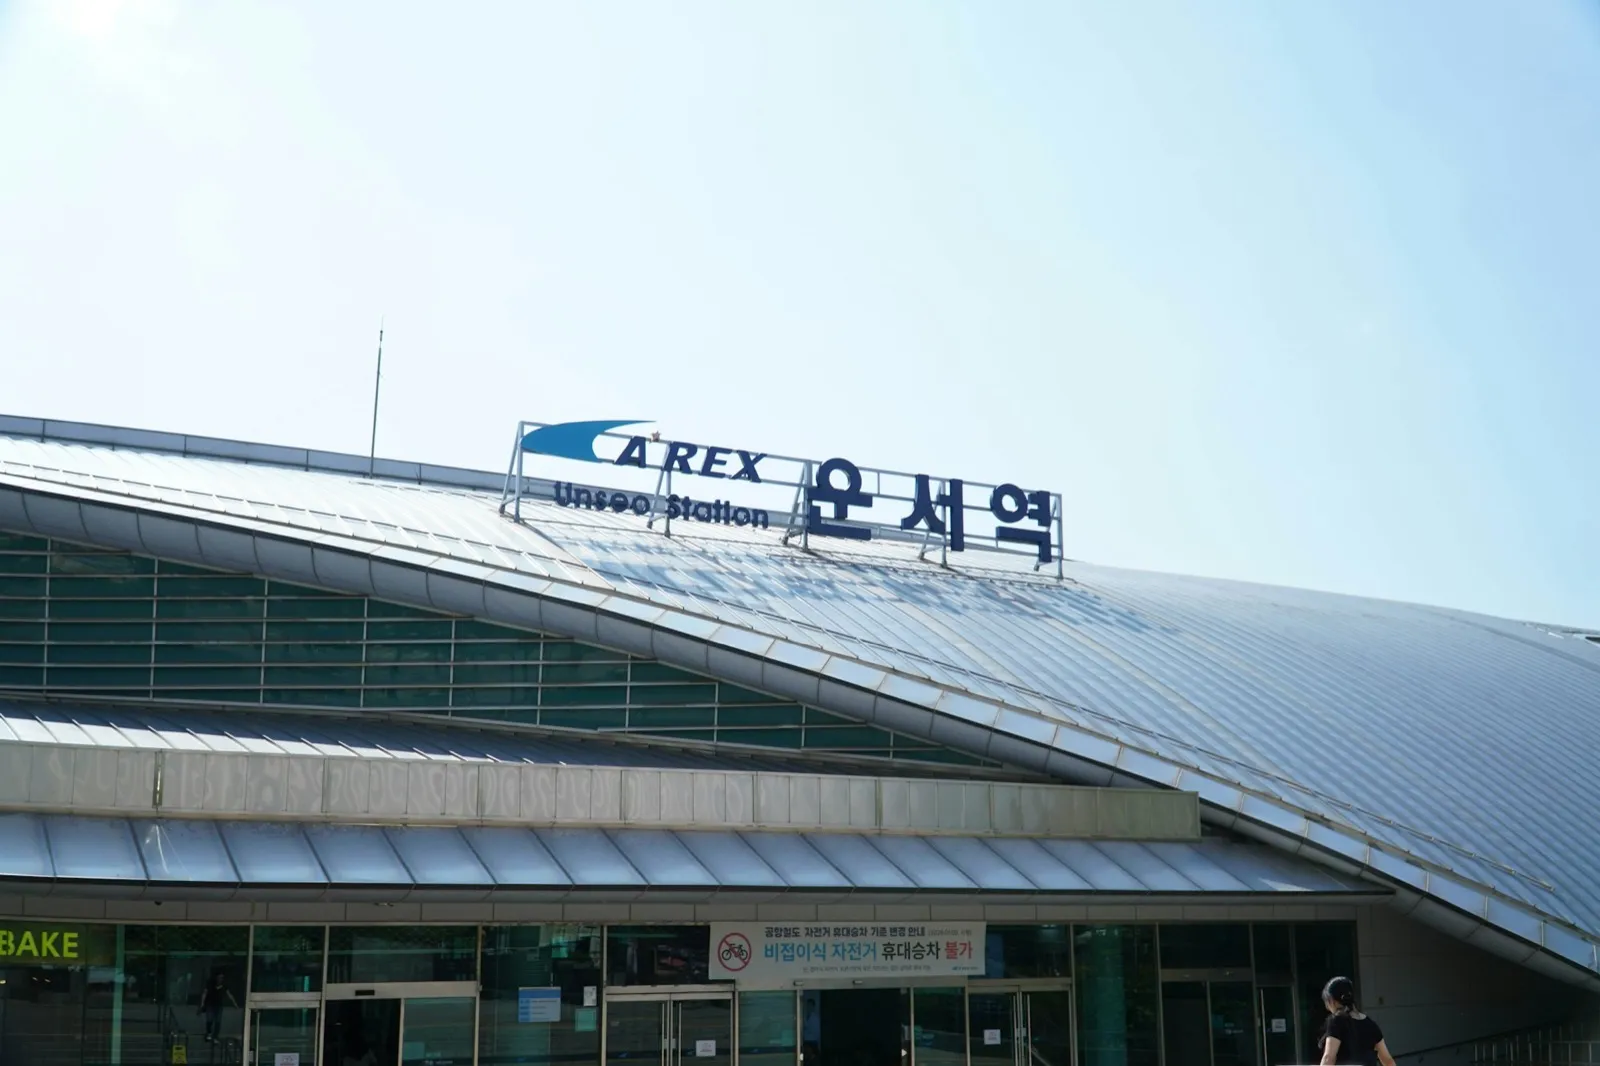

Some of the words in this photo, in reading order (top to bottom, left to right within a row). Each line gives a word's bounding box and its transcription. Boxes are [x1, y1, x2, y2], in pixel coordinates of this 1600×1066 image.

[613, 436, 768, 484] AREX
[553, 480, 650, 516] Unseo
[666, 493, 769, 529] Station
[808, 456, 1052, 563] 운서역
[764, 926, 800, 938] 공항철도
[804, 926, 831, 937] 자전거
[833, 926, 868, 937] 휴대승차
[870, 926, 887, 937] 기준
[889, 926, 906, 937] 변경
[908, 926, 926, 937] 안내
[764, 942, 827, 962] 비접이식
[832, 942, 877, 961] 자전거
[882, 941, 941, 961] 휴대승차
[944, 941, 973, 960] 불가
